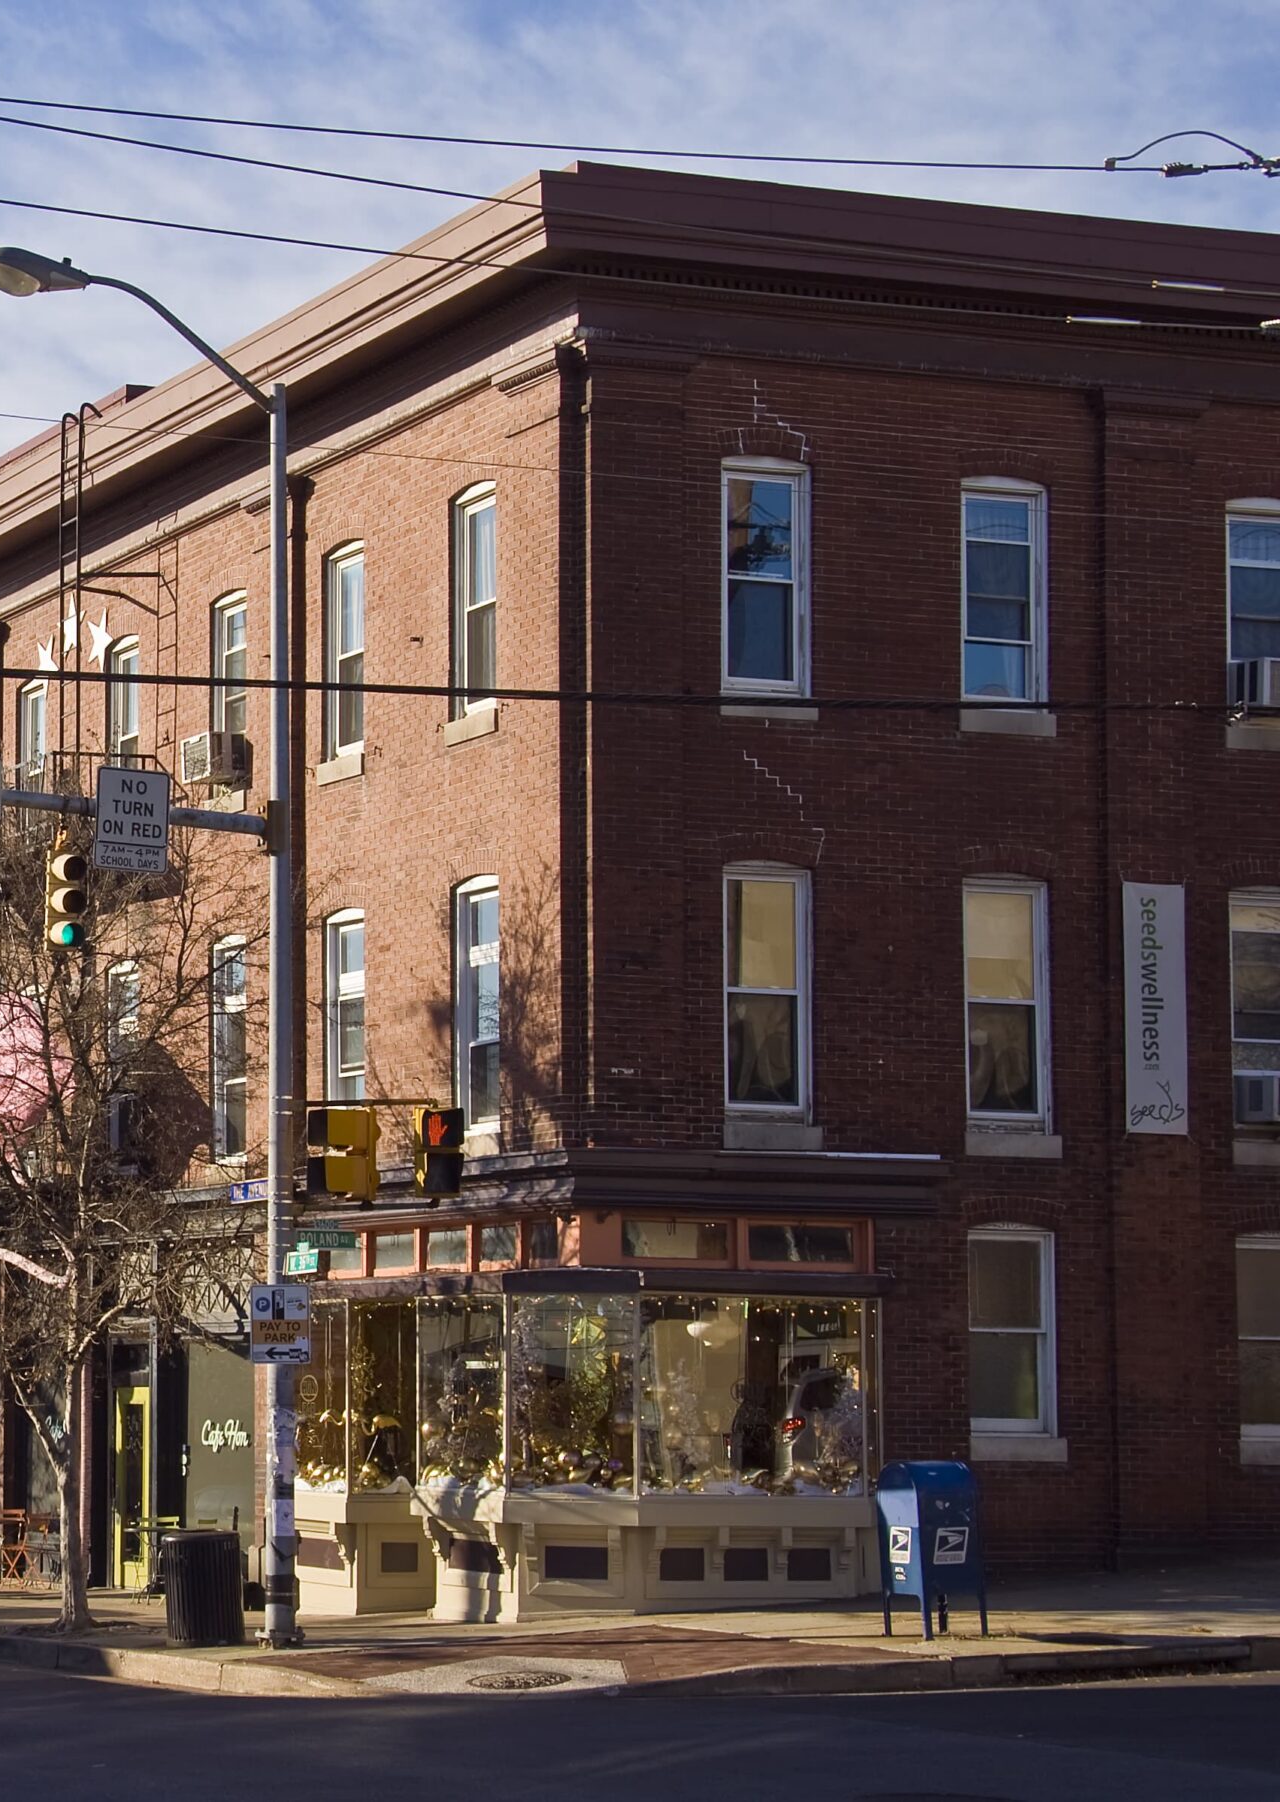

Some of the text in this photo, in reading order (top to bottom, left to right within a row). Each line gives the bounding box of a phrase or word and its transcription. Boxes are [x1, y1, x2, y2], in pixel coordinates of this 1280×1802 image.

[121, 779, 148, 795] NO
[112, 799, 154, 818] TURN
[102, 819, 162, 839] ON RED
[100, 855, 159, 870] SCHOOL DAYS
[247, 1181, 268, 1199] AVENU
[300, 1231, 339, 1247] ROLAND
[259, 1300, 267, 1309] P
[259, 1321, 301, 1332] PAY TO
[264, 1332, 296, 1343] PARK
[201, 1418, 249, 1453] Cafe Hon
